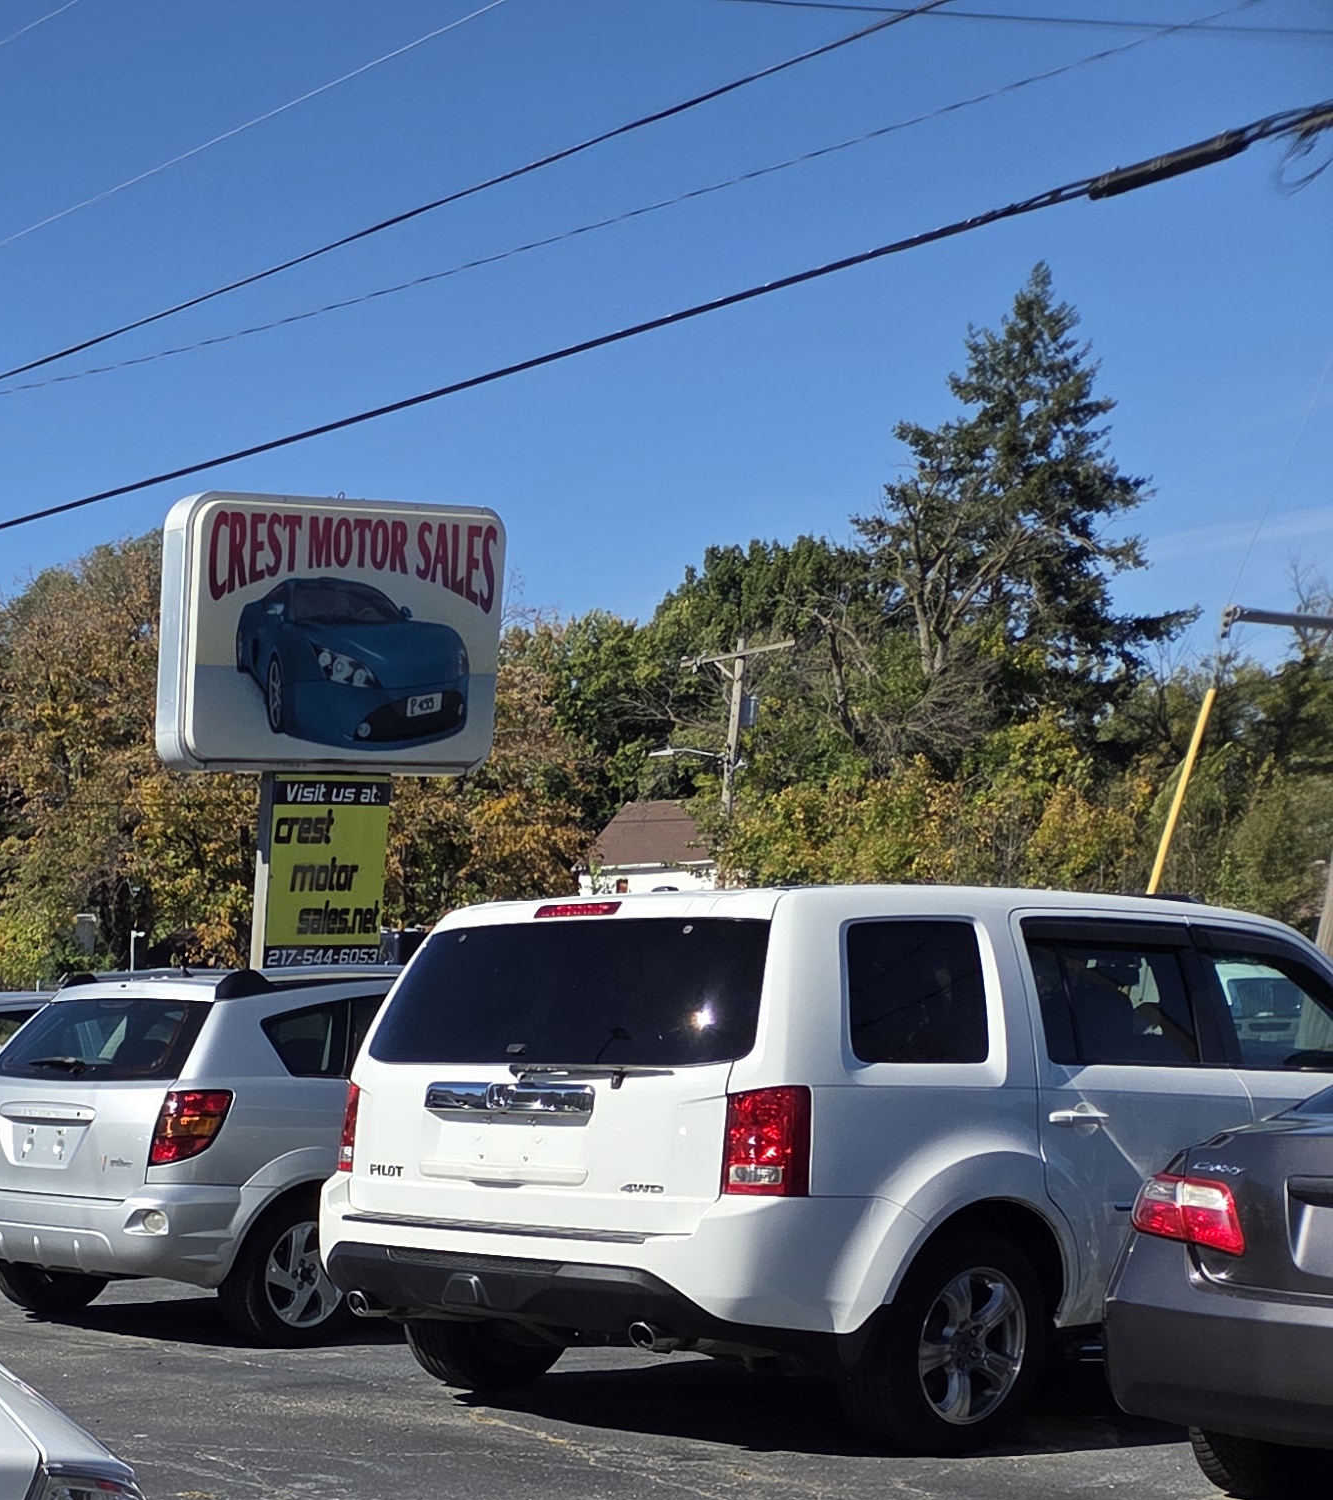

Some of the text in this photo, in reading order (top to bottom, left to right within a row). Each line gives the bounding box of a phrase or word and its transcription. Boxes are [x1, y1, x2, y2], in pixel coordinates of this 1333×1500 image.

[209, 511, 498, 614] CREST MOTOR SALES
[286, 783, 382, 804] Visit us at:
[274, 808, 335, 845] crest
[289, 856, 360, 892] motor
[296, 900, 381, 936] sales.net
[267, 948, 379, 966] 217-544-6053
[370, 1163, 405, 1178] PILOT
[620, 1183, 665, 1194] 4WD
